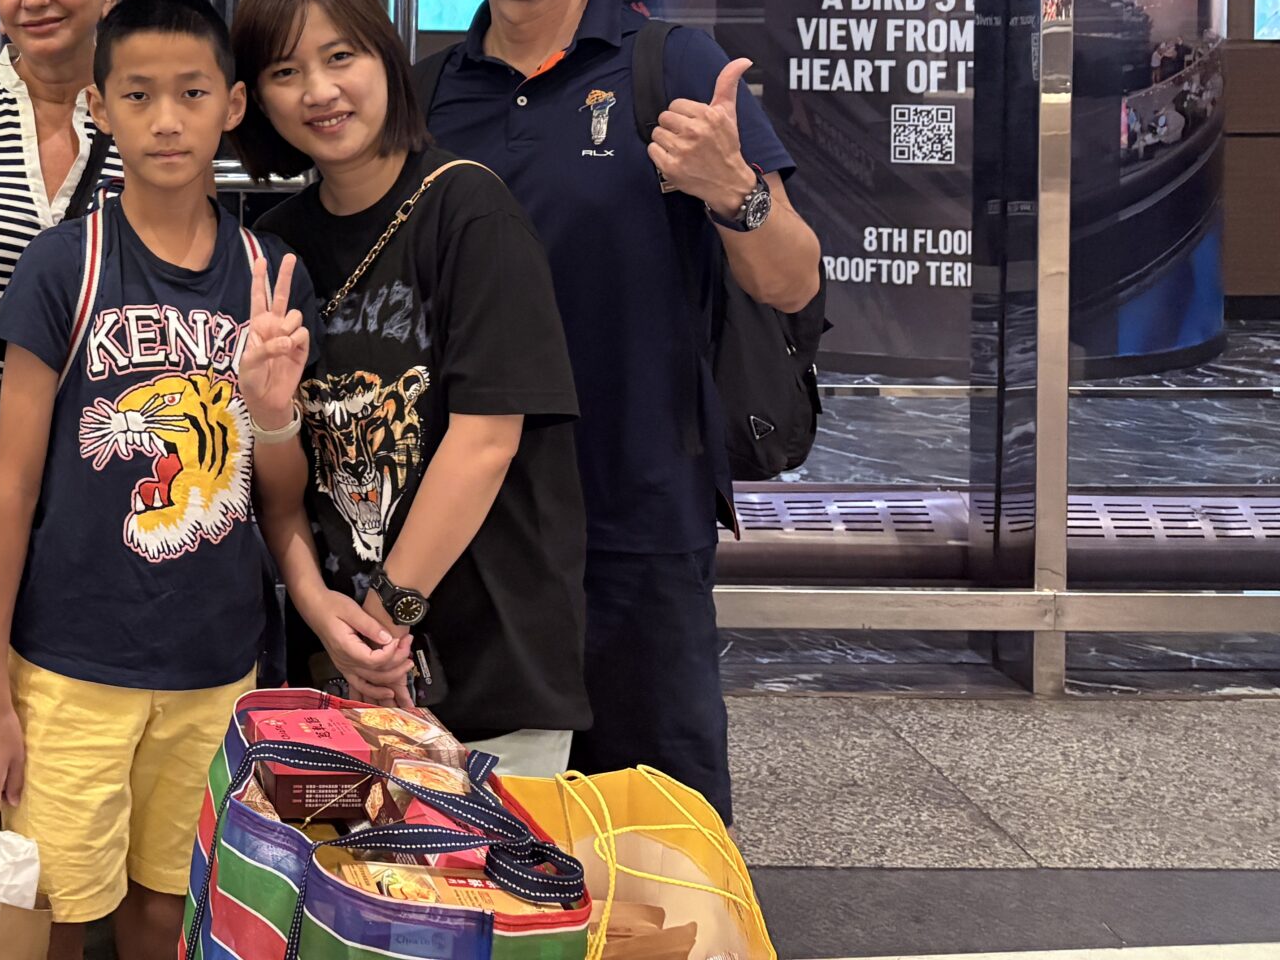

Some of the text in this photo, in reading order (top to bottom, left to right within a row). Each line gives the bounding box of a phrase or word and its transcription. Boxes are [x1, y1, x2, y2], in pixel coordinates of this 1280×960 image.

[796, 17, 974, 54] VIEW FROM
[789, 57, 897, 93] HEART
[906, 59, 948, 94] OF
[581, 149, 615, 157] RLX
[862, 226, 908, 254] 8TH
[822, 255, 920, 285] ROOFTOP
[86, 304, 250, 383] KENZ
